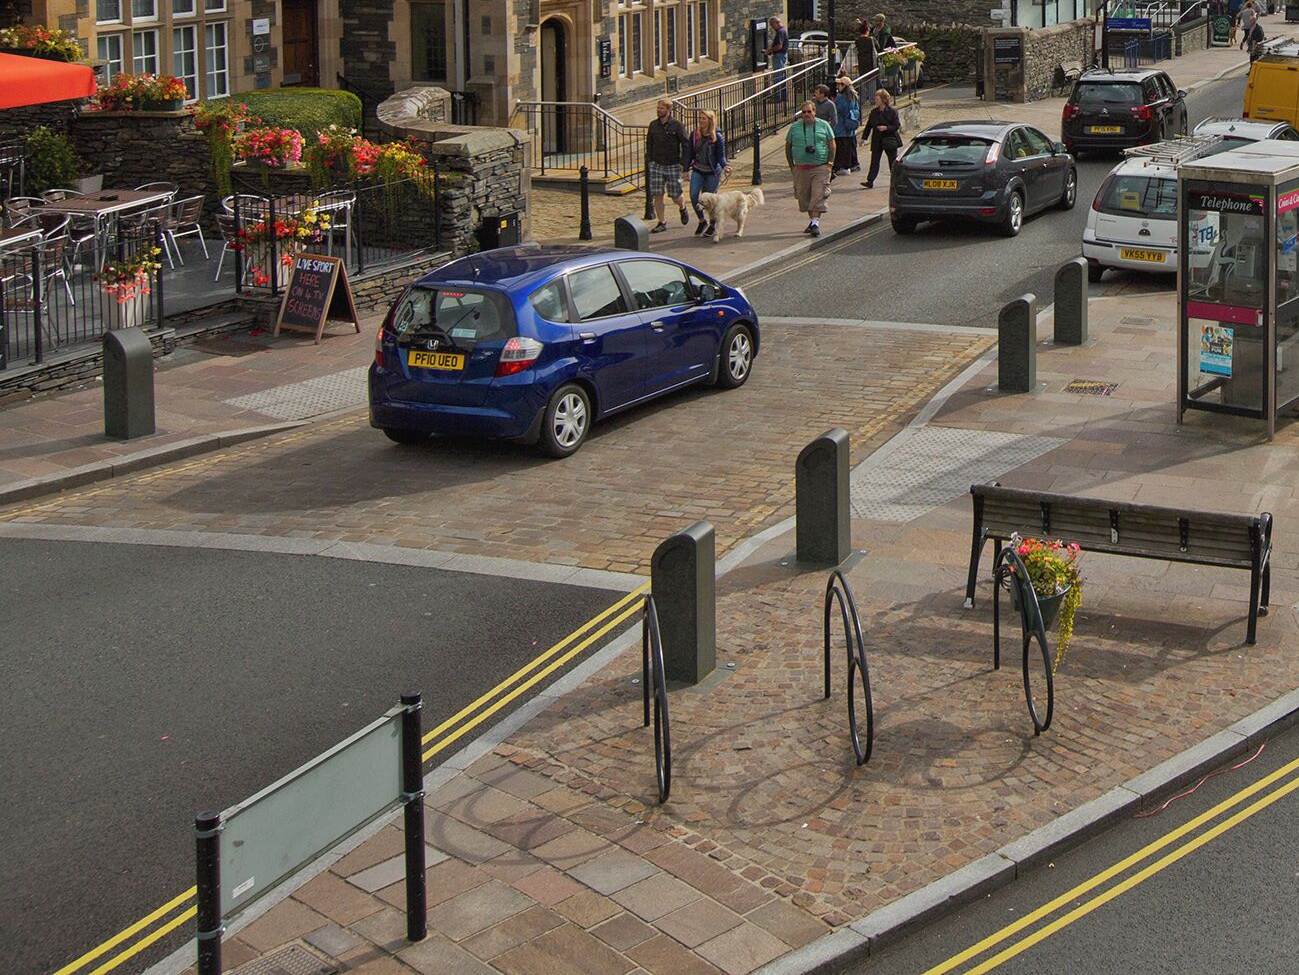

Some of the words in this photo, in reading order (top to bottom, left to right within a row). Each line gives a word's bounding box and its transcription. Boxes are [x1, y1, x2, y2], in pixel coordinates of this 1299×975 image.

[1200, 195, 1252, 212] Telephone
[1124, 249, 1145, 259] VK55
[1147, 251, 1162, 261] YYB
[297, 258, 312, 271] LIVE
[312, 260, 335, 273] SPORT
[300, 273, 322, 286] HERE
[414, 353, 437, 366] PF10
[438, 354, 458, 368] UEO
